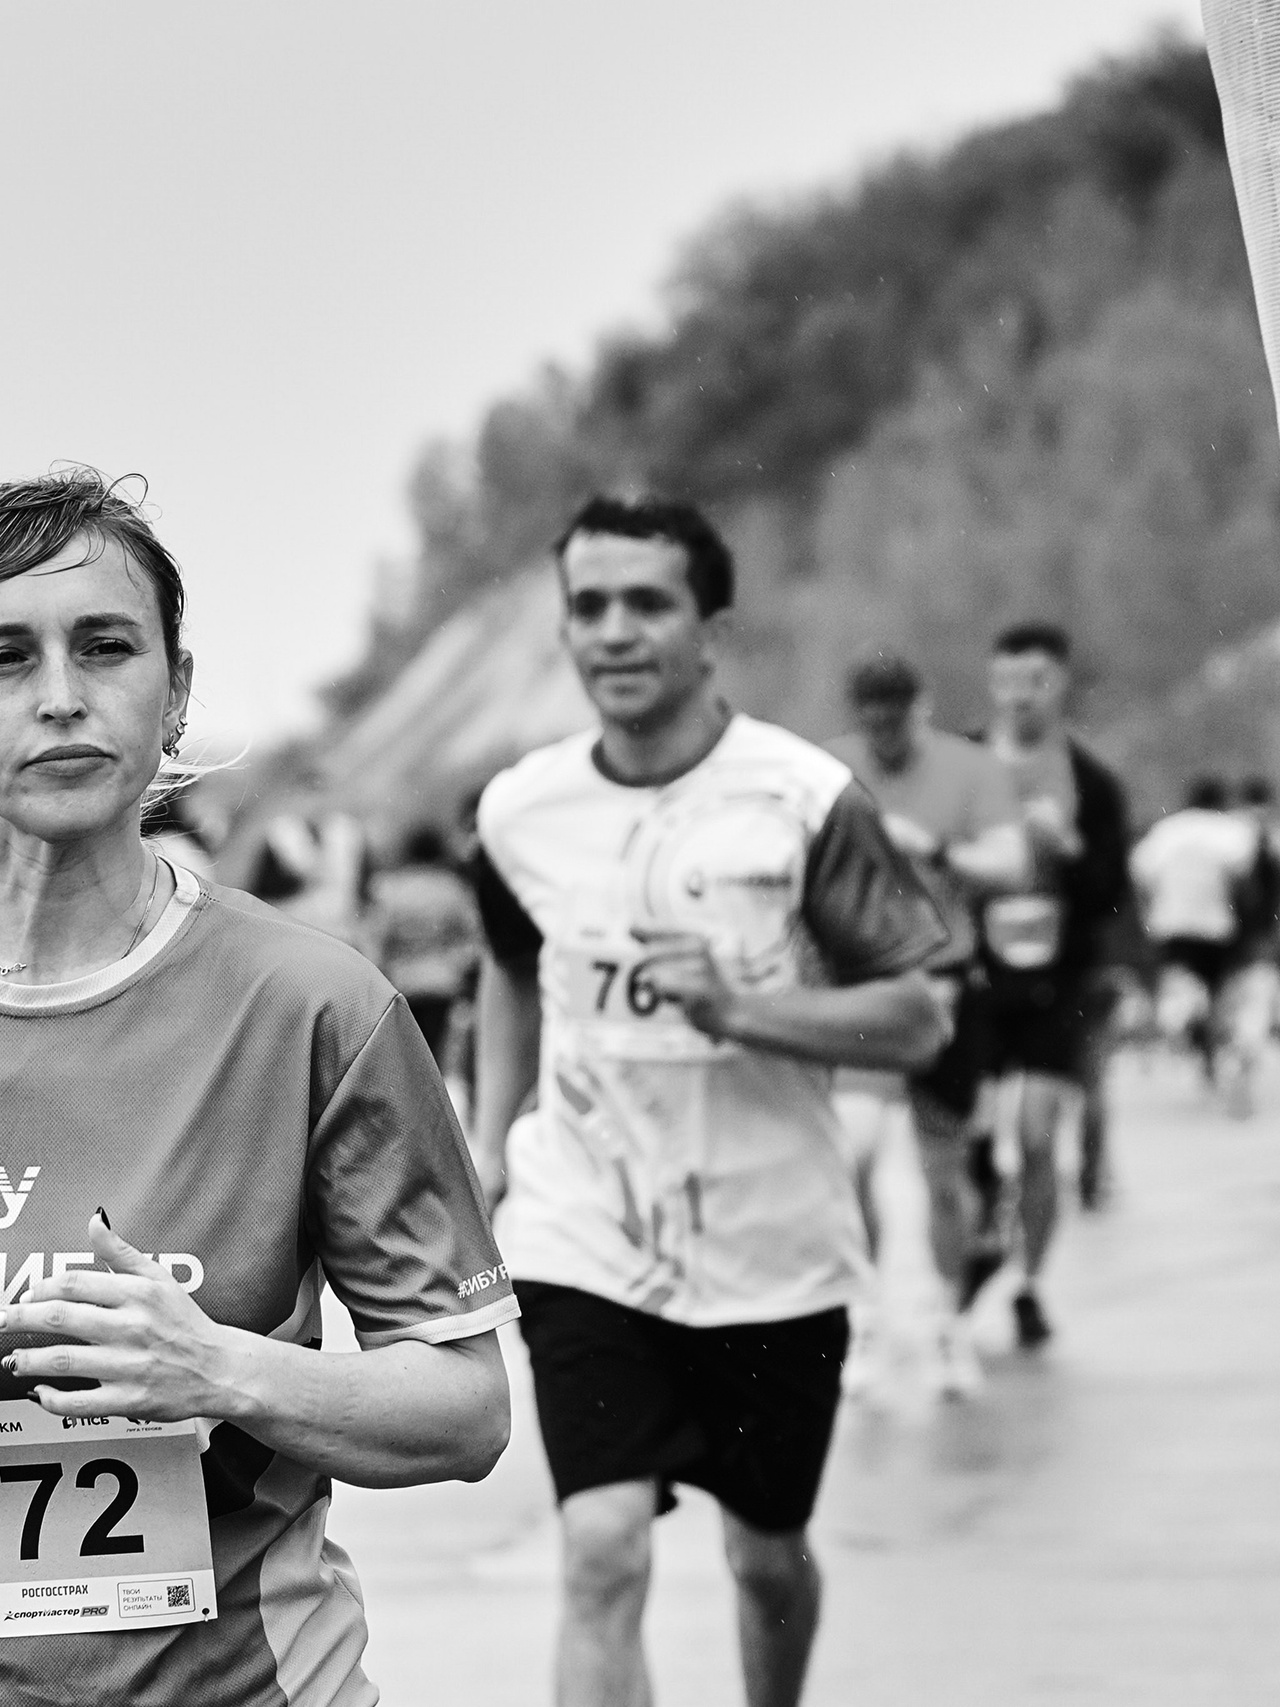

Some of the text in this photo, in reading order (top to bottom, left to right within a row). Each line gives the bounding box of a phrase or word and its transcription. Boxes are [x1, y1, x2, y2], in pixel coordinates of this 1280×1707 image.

[590, 957, 662, 1016] 76
[0, 1421, 23, 1433] КМ
[80, 1415, 110, 1427] ПСБ
[22, 1584, 89, 1598] РОСГОССТРАХ
[123, 1595, 163, 1603] РЕЗУЛЬТАТЫ
[82, 1606, 108, 1616] PRO
[123, 1603, 152, 1611] ОНЛАЙН
